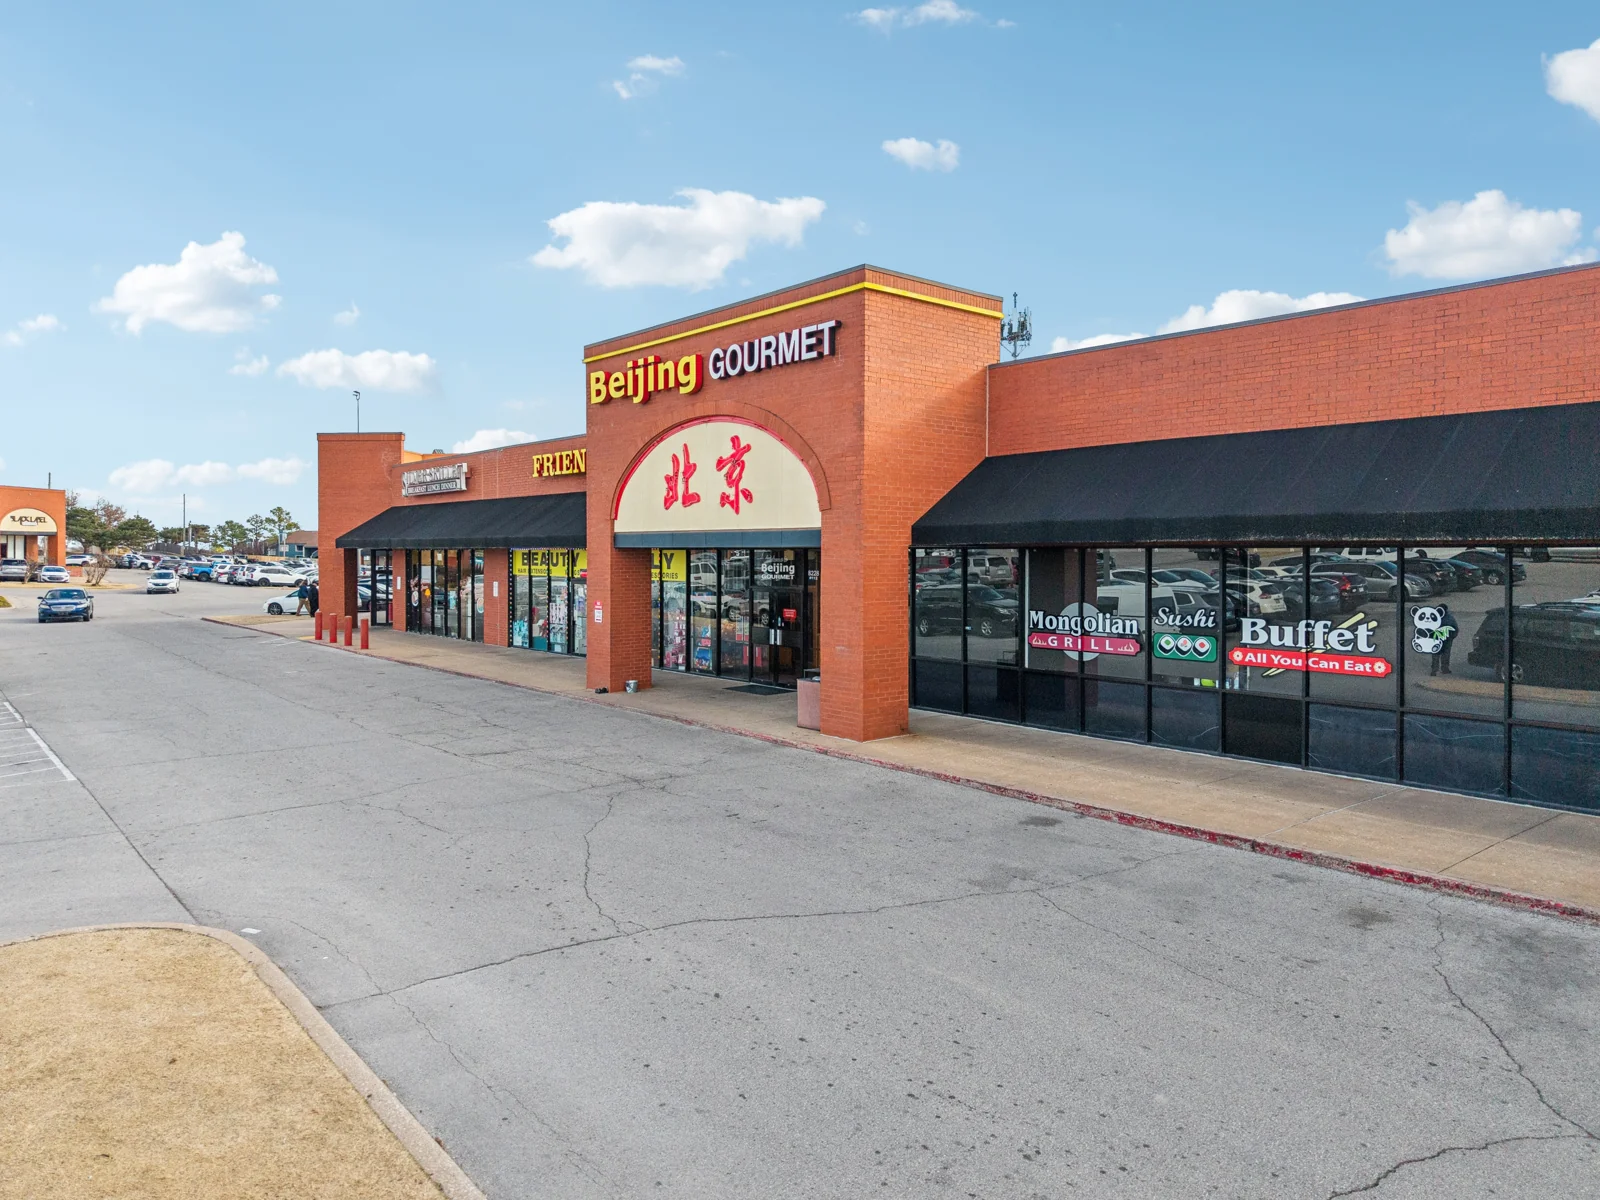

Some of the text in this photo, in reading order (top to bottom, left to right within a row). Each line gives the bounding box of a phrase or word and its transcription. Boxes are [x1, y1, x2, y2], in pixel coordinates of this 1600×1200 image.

[590, 320, 841, 404] Beijing GOURMET
[532, 448, 587, 478] FRIEN
[664, 435, 753, 515] 北京
[521, 551, 580, 567] BEAUTY
[761, 562, 795, 575] Beijing
[1029, 610, 1139, 636] Mongolian
[1155, 606, 1216, 628] Sushi
[1047, 636, 1114, 651] GRILL
[1239, 617, 1376, 653] Buffet
[1244, 653, 1373, 673] All You Can Eat
